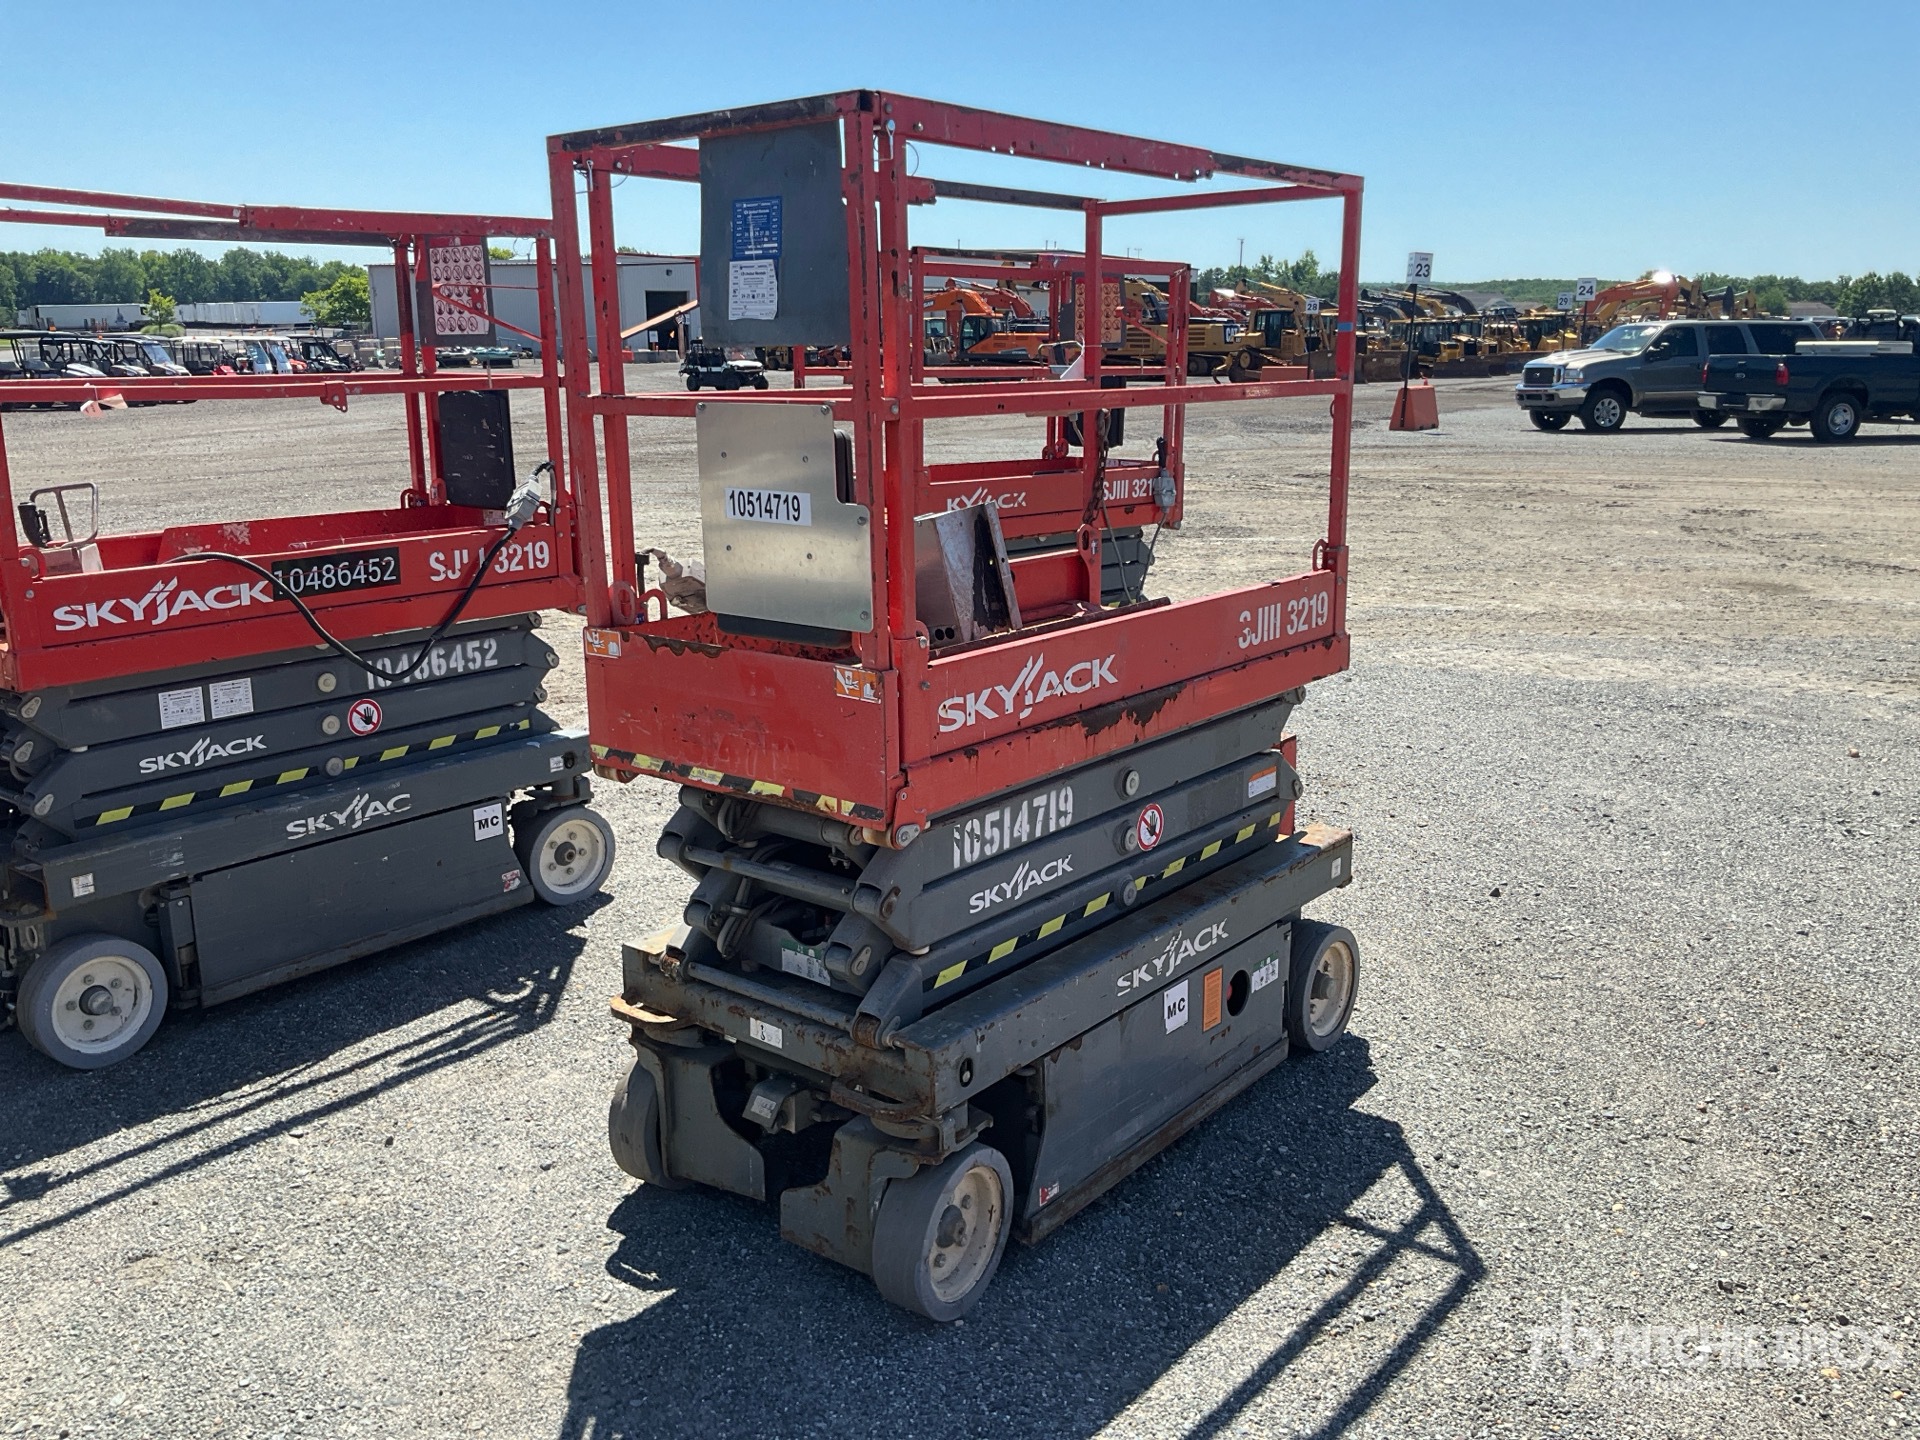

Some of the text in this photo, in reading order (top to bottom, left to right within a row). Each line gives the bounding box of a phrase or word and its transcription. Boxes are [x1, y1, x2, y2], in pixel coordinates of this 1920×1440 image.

[1415, 263, 1430, 277] 23
[1307, 303, 1318, 311] 28
[1559, 297, 1569, 305] 29
[1579, 285, 1594, 296] 24
[729, 490, 801, 522] 10514719
[494, 540, 550, 574] 3219
[53, 576, 274, 631] SKYJACK
[1286, 590, 1329, 635] 3219
[367, 638, 498, 690] 10486452
[938, 652, 1119, 733] SKYJACK
[138, 734, 268, 774] SKYJACK
[478, 815, 500, 831] MC
[953, 785, 1074, 869] 10514719
[969, 853, 1074, 914] SKYJACK
[1116, 917, 1230, 997] SKYJACK
[1167, 997, 1186, 1020] MC
